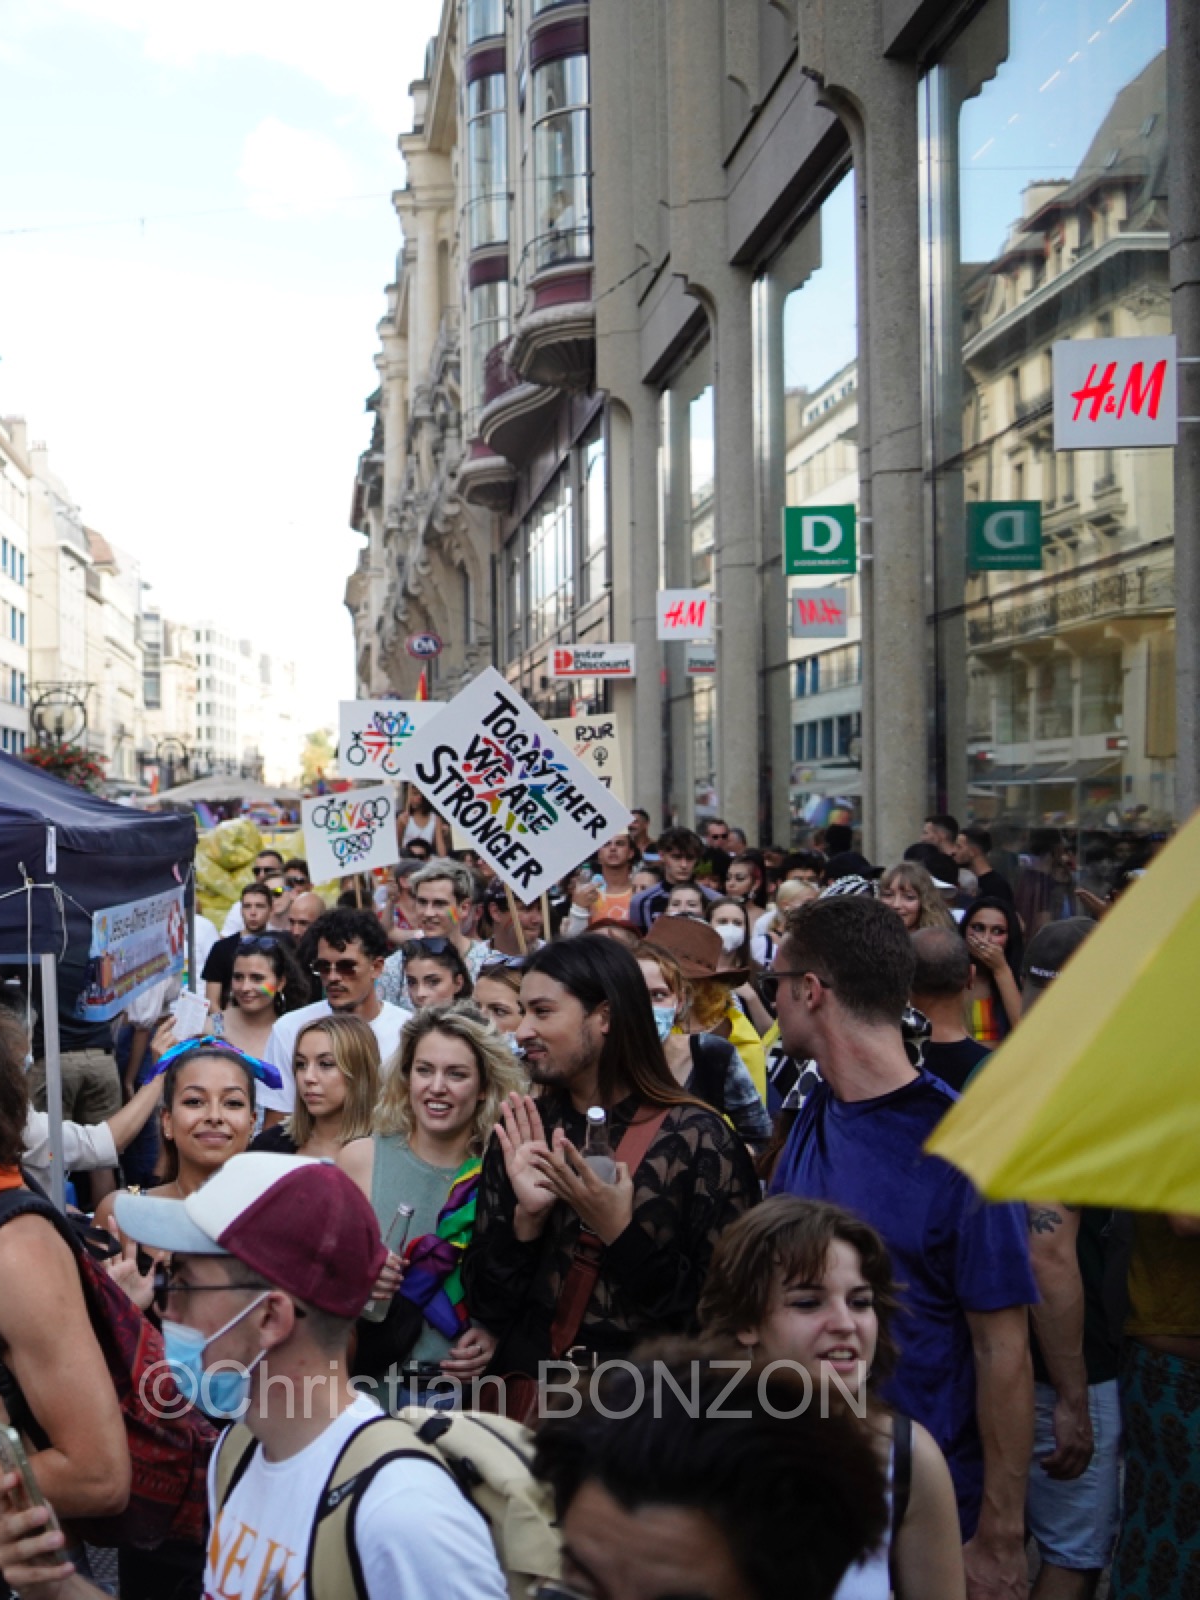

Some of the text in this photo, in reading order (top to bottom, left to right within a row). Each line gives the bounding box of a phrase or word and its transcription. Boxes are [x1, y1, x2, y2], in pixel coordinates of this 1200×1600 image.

[1070, 359, 1167, 422] H&M
[802, 515, 843, 554] D
[463, 734, 554, 836] WE ARE
[482, 690, 608, 840] TOGAYTHER
[416, 745, 543, 890] STRONGER
